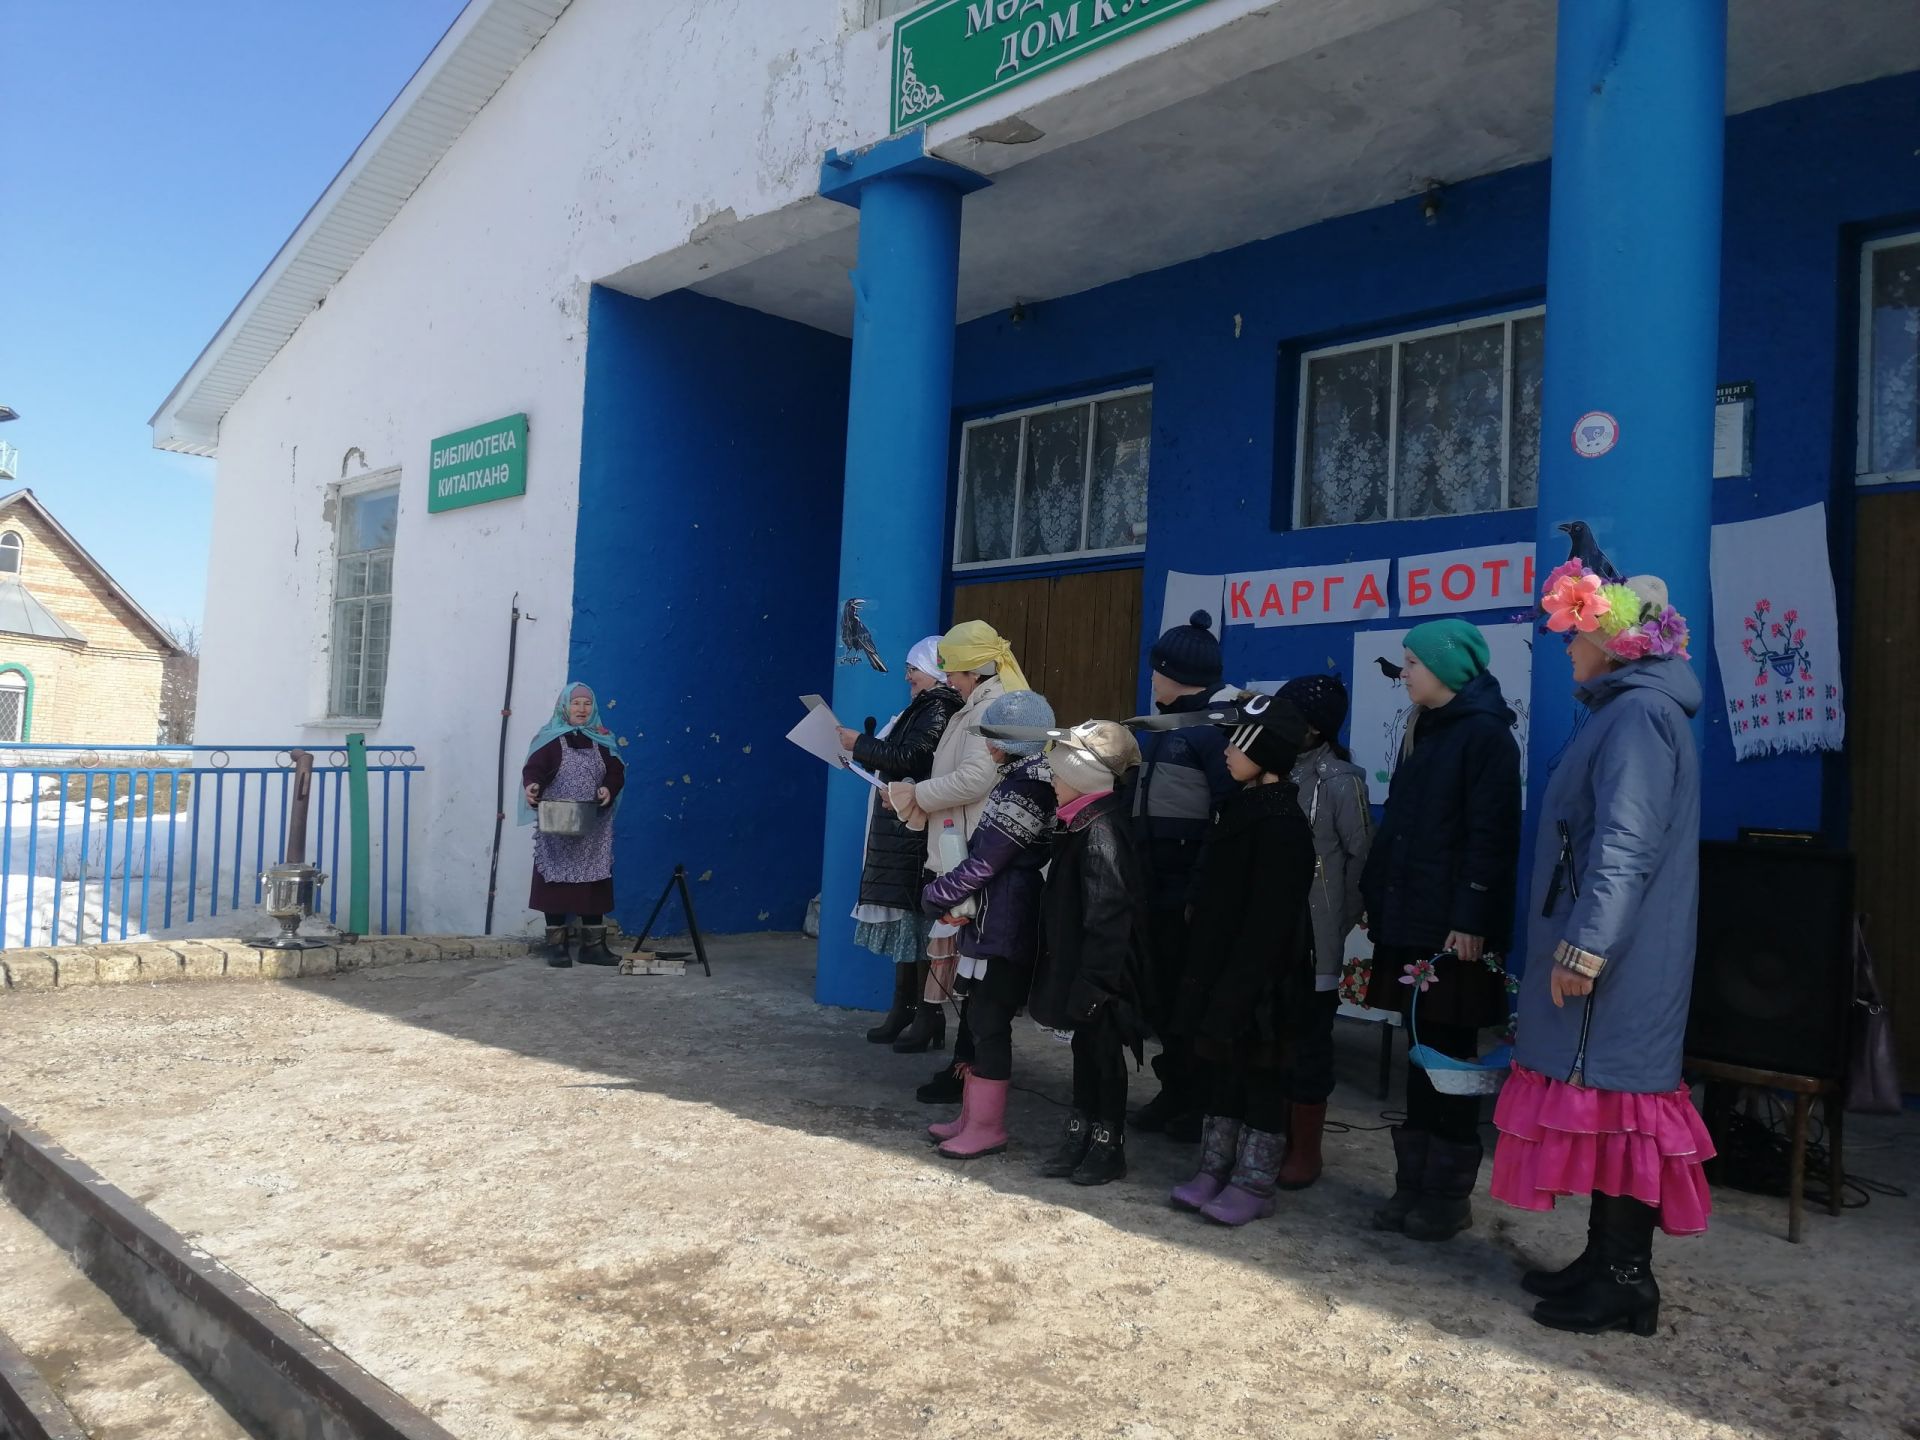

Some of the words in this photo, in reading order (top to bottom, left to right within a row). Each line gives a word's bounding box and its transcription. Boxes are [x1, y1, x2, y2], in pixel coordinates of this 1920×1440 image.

[995, 1, 1081, 81] ДОМ
[1716, 385, 1749, 397] НИЯТ
[433, 430, 516, 470] БИБЛИОТЕКА
[438, 463, 510, 498] КИТАПХАНӘ
[1230, 573, 1387, 619] КАРГА
